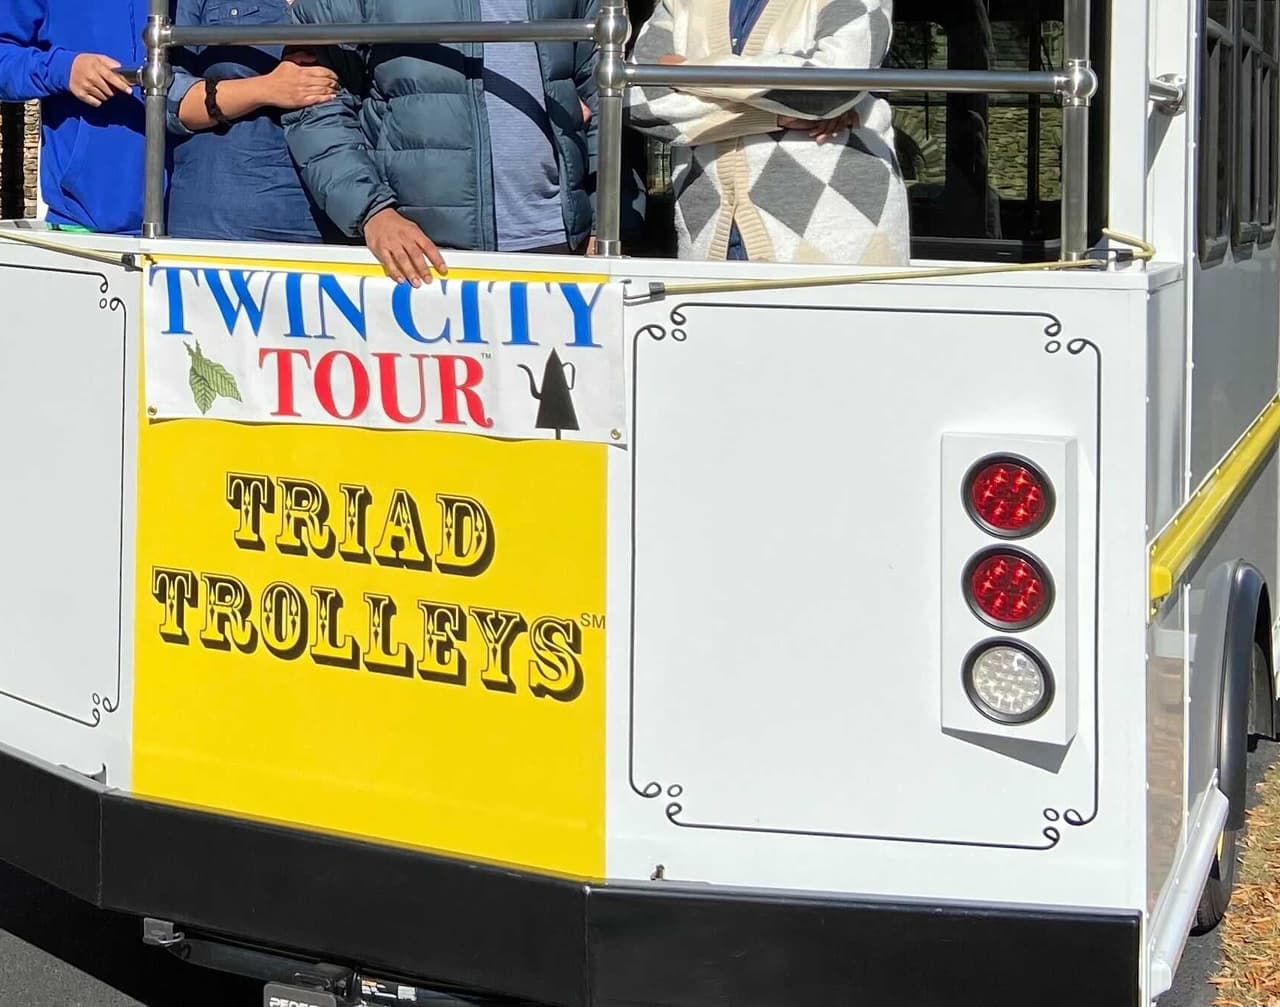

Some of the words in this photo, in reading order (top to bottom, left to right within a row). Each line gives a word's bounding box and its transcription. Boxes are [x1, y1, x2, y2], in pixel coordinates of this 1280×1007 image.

[148, 266, 368, 341] TWIN
[391, 279, 605, 348] CITY
[258, 347, 495, 429] TOUR
[226, 471, 495, 578] TRIAD
[152, 565, 584, 702] TROLLEYS
